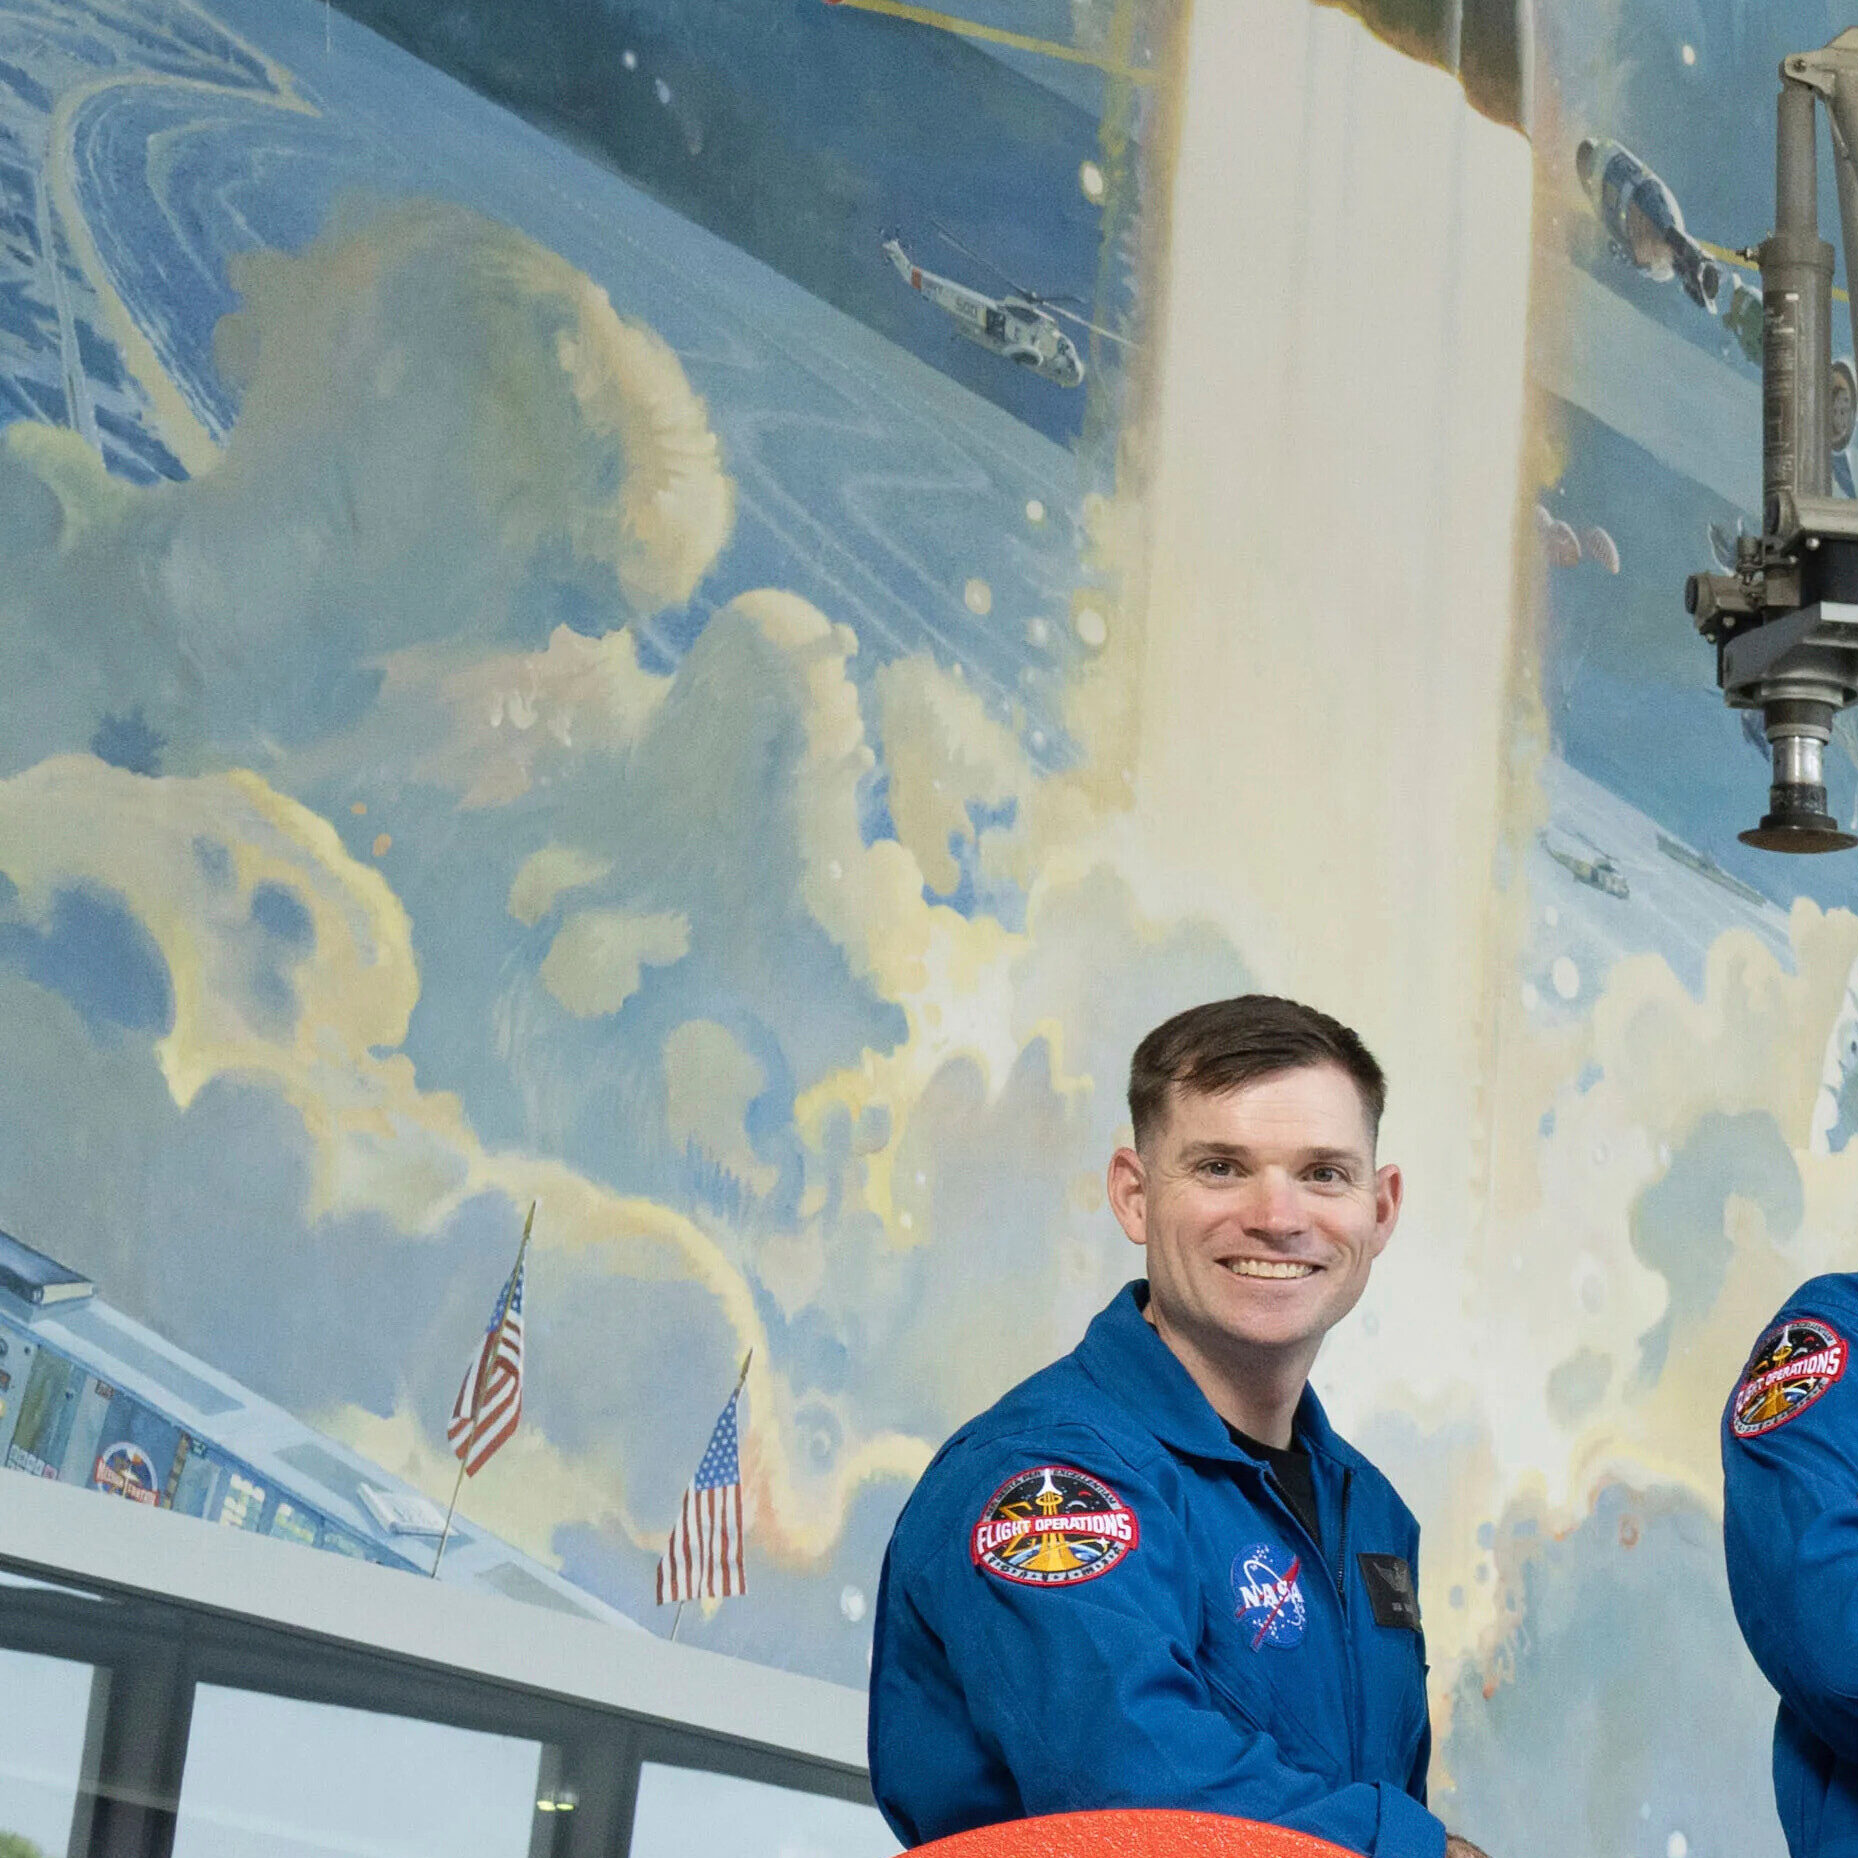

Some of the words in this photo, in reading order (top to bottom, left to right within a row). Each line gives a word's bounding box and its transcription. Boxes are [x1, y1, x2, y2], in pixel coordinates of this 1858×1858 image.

[1765, 1347, 1841, 1386] OPERATIONS
[976, 1519, 1032, 1554] FLIGHT
[1035, 1513, 1132, 1541] OPERATIONS
[1239, 1580, 1305, 1609] NASA
